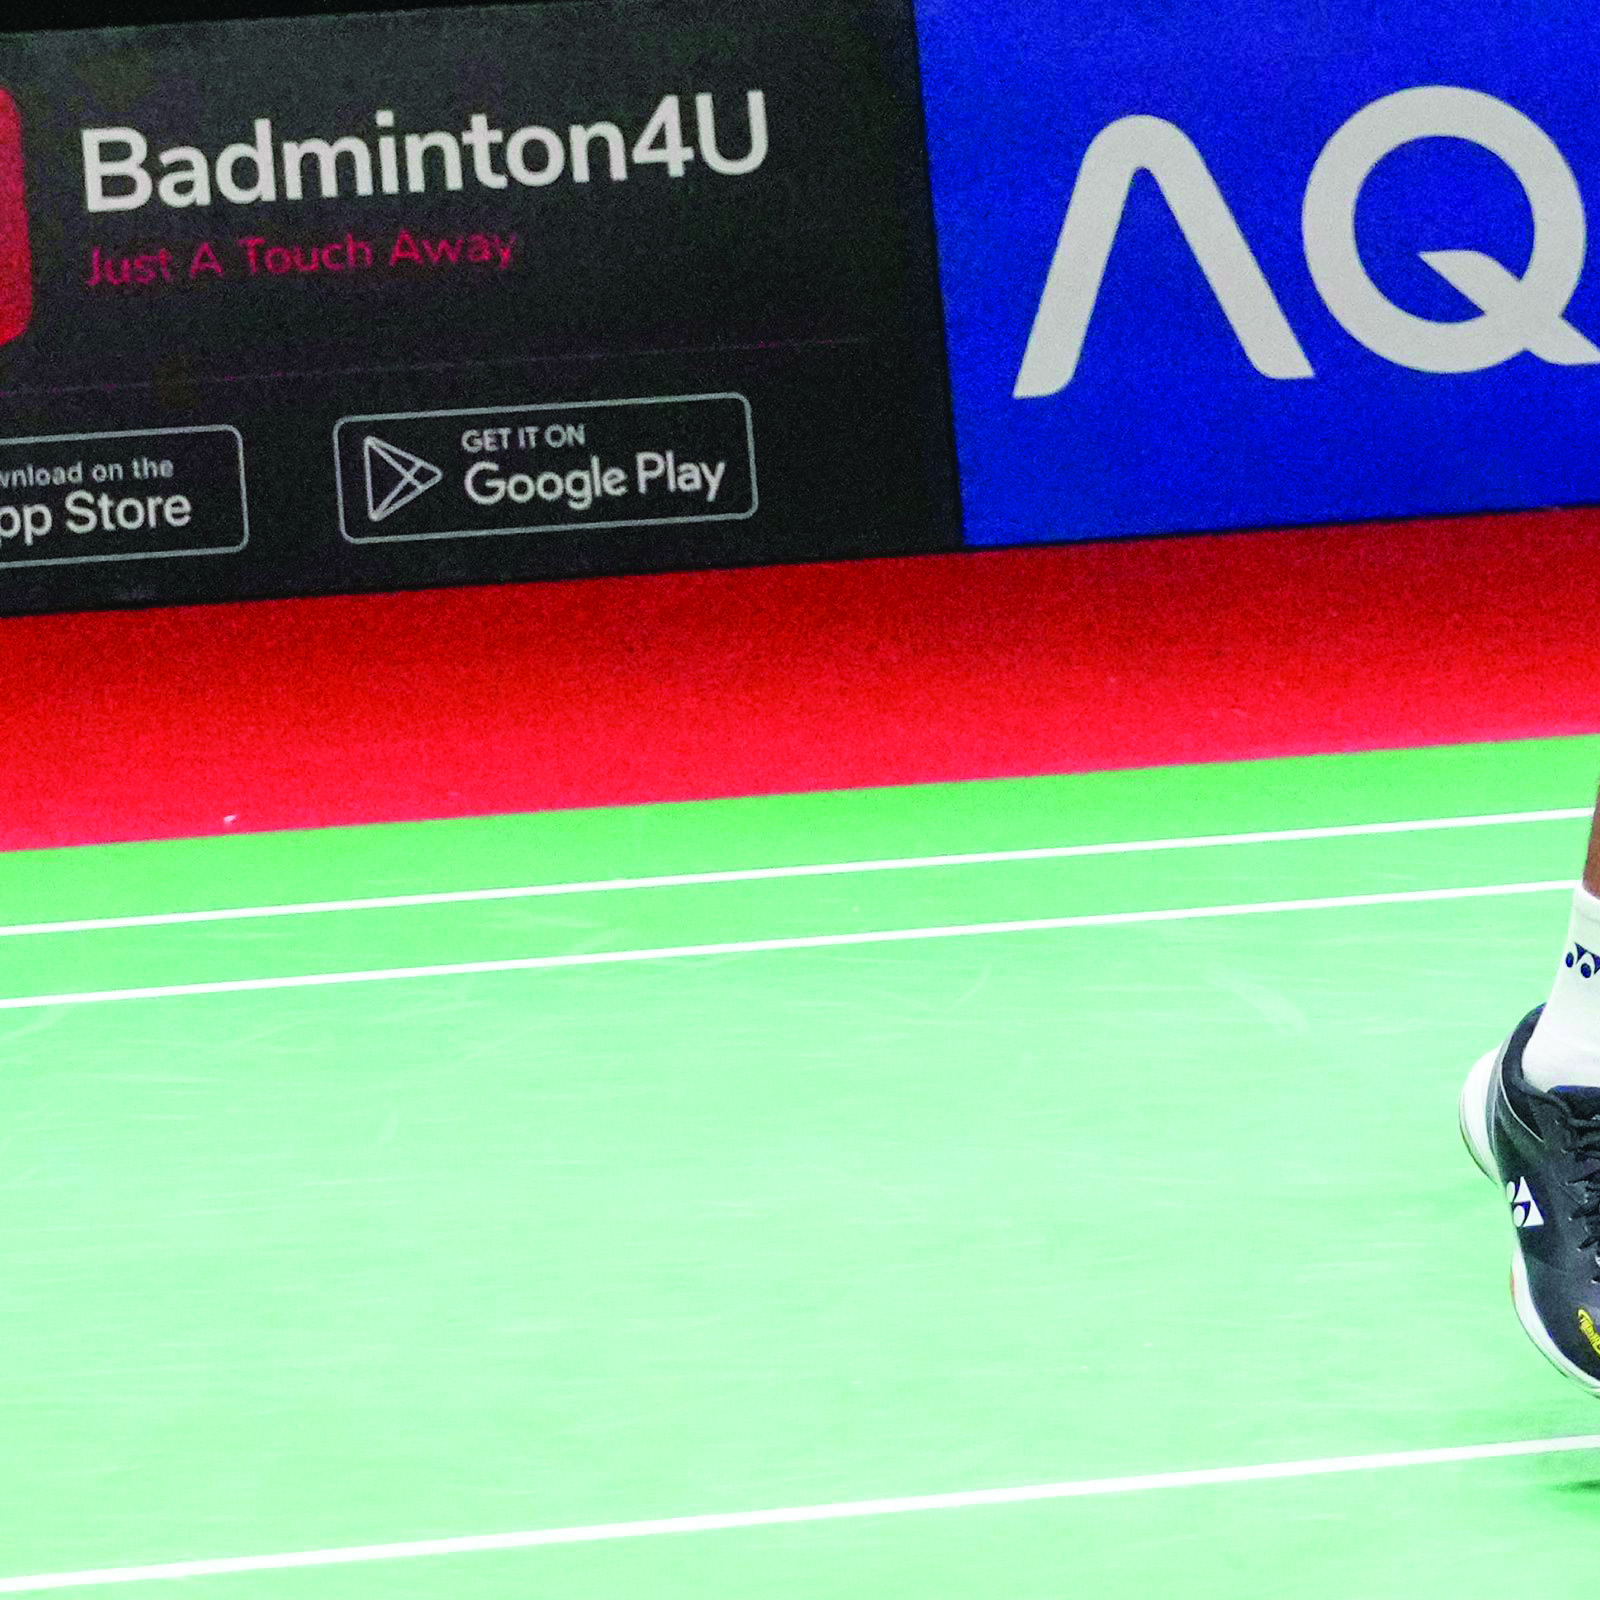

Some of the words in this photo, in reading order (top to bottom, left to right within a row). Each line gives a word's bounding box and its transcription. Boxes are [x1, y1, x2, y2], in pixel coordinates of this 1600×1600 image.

[80, 89, 771, 213] Badminton4U
[86, 245, 174, 287] Just
[189, 240, 223, 278] A
[238, 232, 373, 275] Touch
[388, 227, 517, 271] Away
[461, 426, 512, 453] GET
[517, 425, 539, 450] IT
[544, 422, 587, 449] ON
[92, 462, 124, 483] on
[132, 455, 174, 480] the
[464, 454, 629, 511] Google
[635, 450, 726, 503] Play
[64, 489, 192, 535] Store
